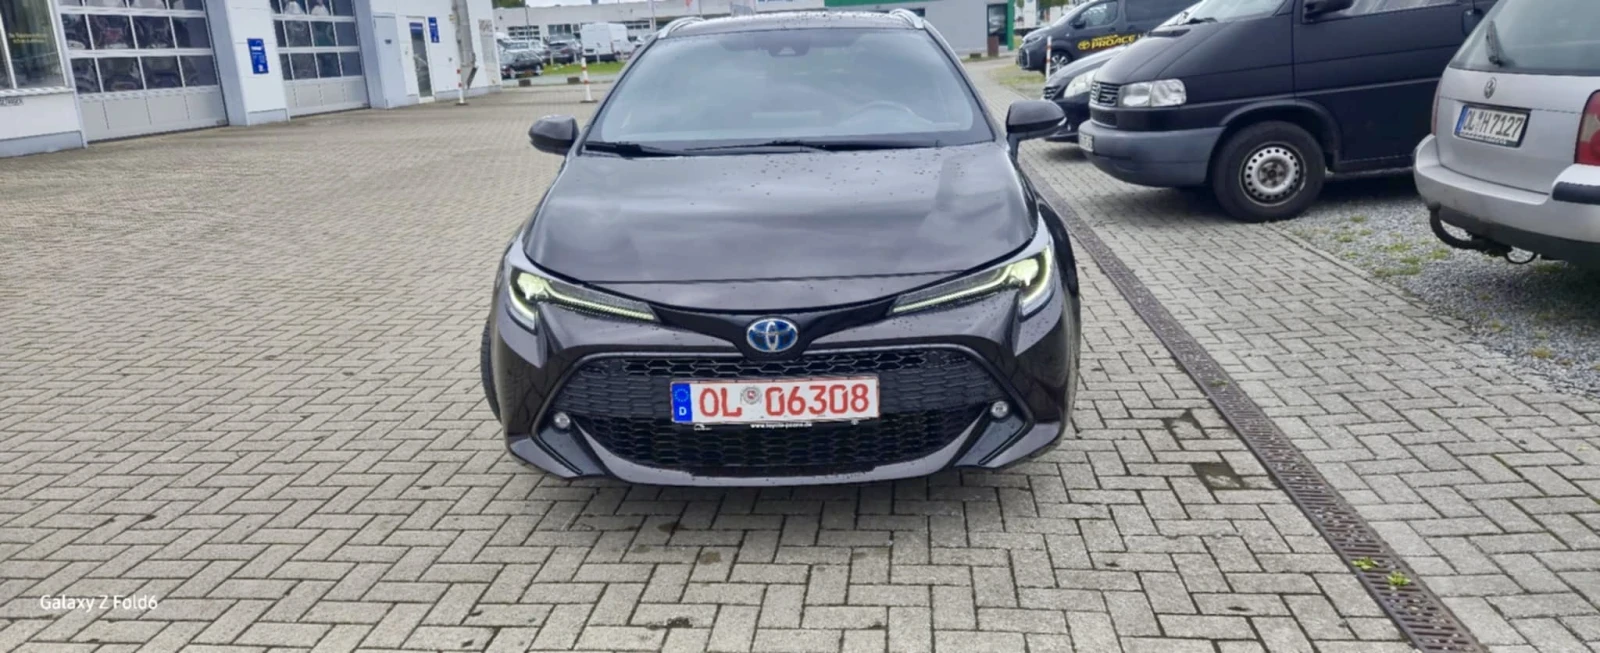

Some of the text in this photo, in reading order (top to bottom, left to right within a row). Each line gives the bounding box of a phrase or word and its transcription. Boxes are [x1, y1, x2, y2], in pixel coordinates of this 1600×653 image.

[1091, 34, 1136, 49] PROACE
[1479, 112, 1492, 133] H
[1490, 114, 1525, 138] 7127
[700, 384, 869, 417] OL 06308
[679, 406, 687, 416] D
